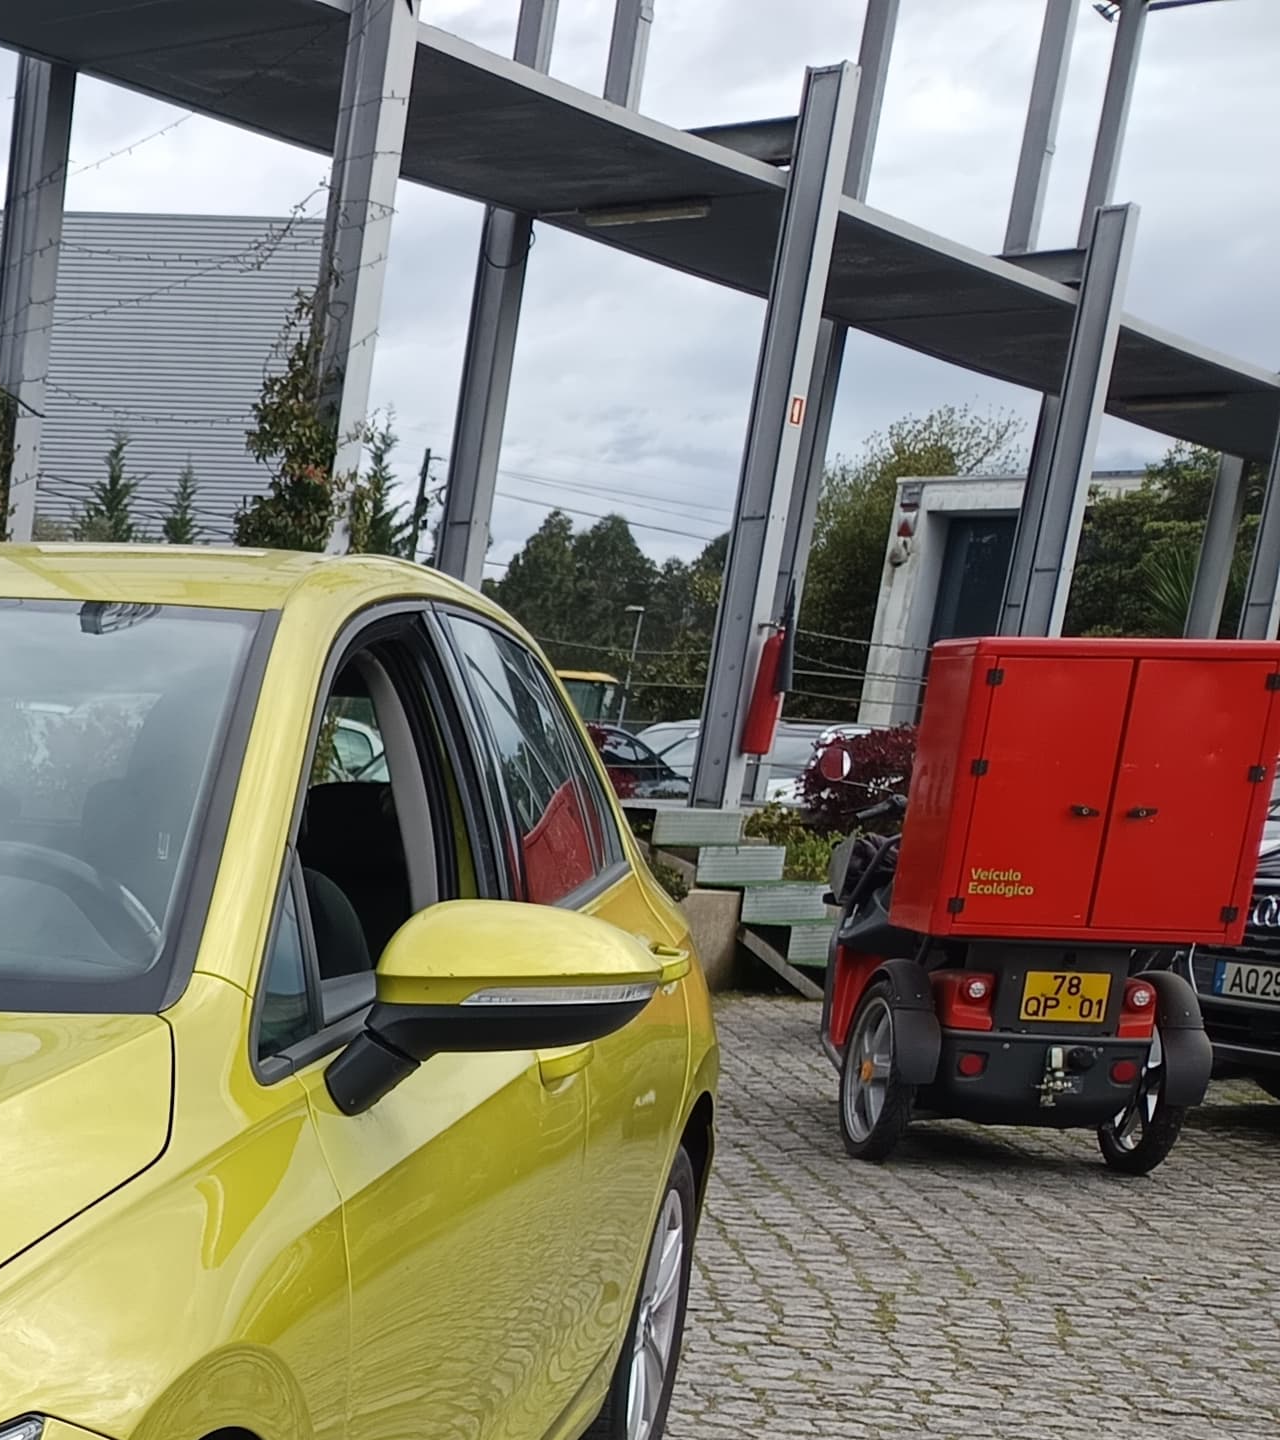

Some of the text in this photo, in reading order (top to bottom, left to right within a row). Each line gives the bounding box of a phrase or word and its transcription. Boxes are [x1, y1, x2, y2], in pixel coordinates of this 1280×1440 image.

[971, 867, 1022, 881] Veículo
[967, 881, 1034, 898] Ecológico
[1053, 975, 1082, 996] 78
